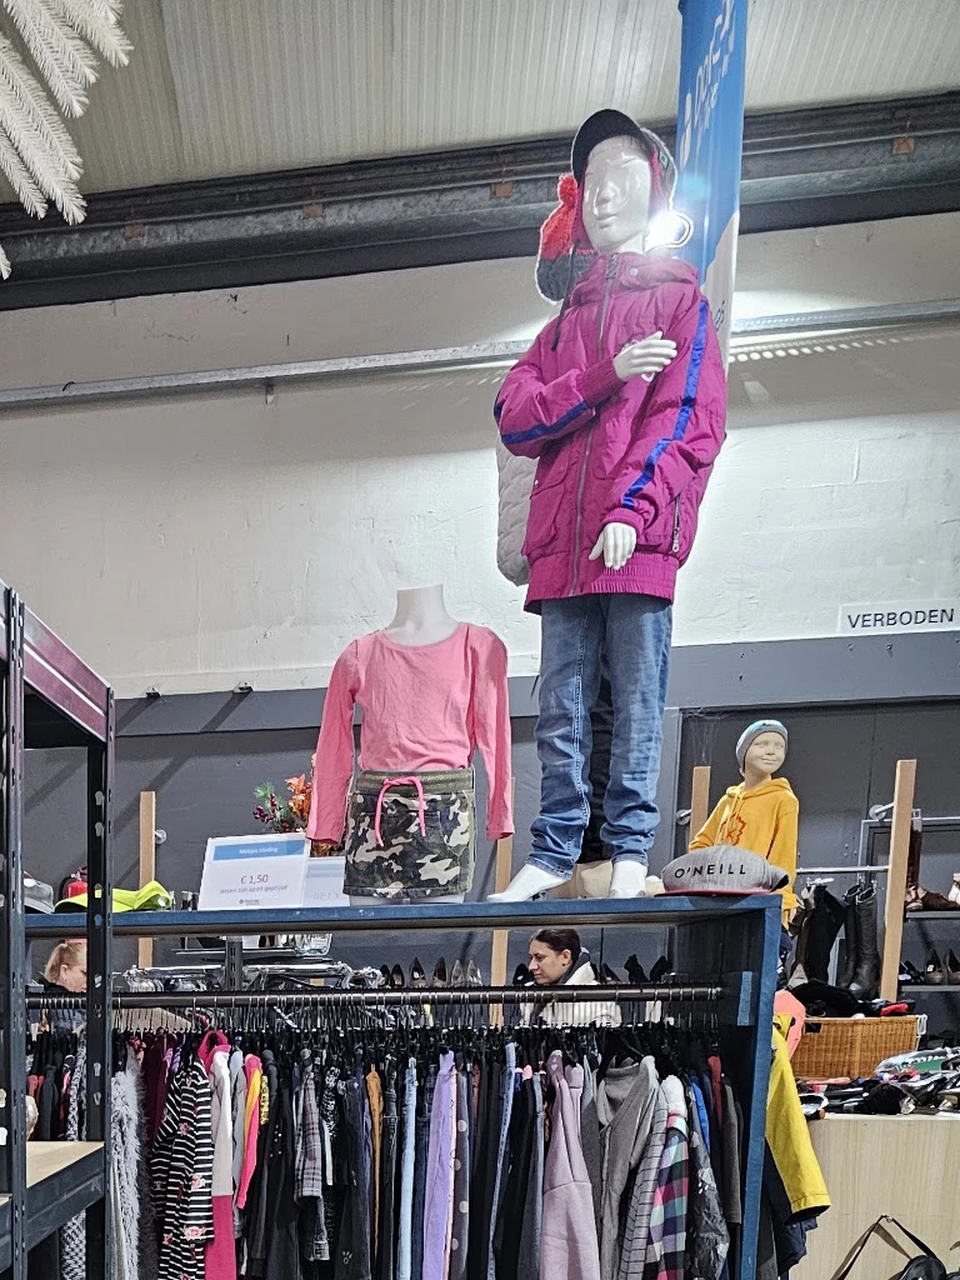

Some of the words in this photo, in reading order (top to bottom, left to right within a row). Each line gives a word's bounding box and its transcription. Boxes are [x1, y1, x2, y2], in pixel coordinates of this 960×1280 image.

[847, 608, 955, 629] VERBODEN
[674, 864, 746, 879] O'NEILL
[248, 874, 269, 885] 1,50
